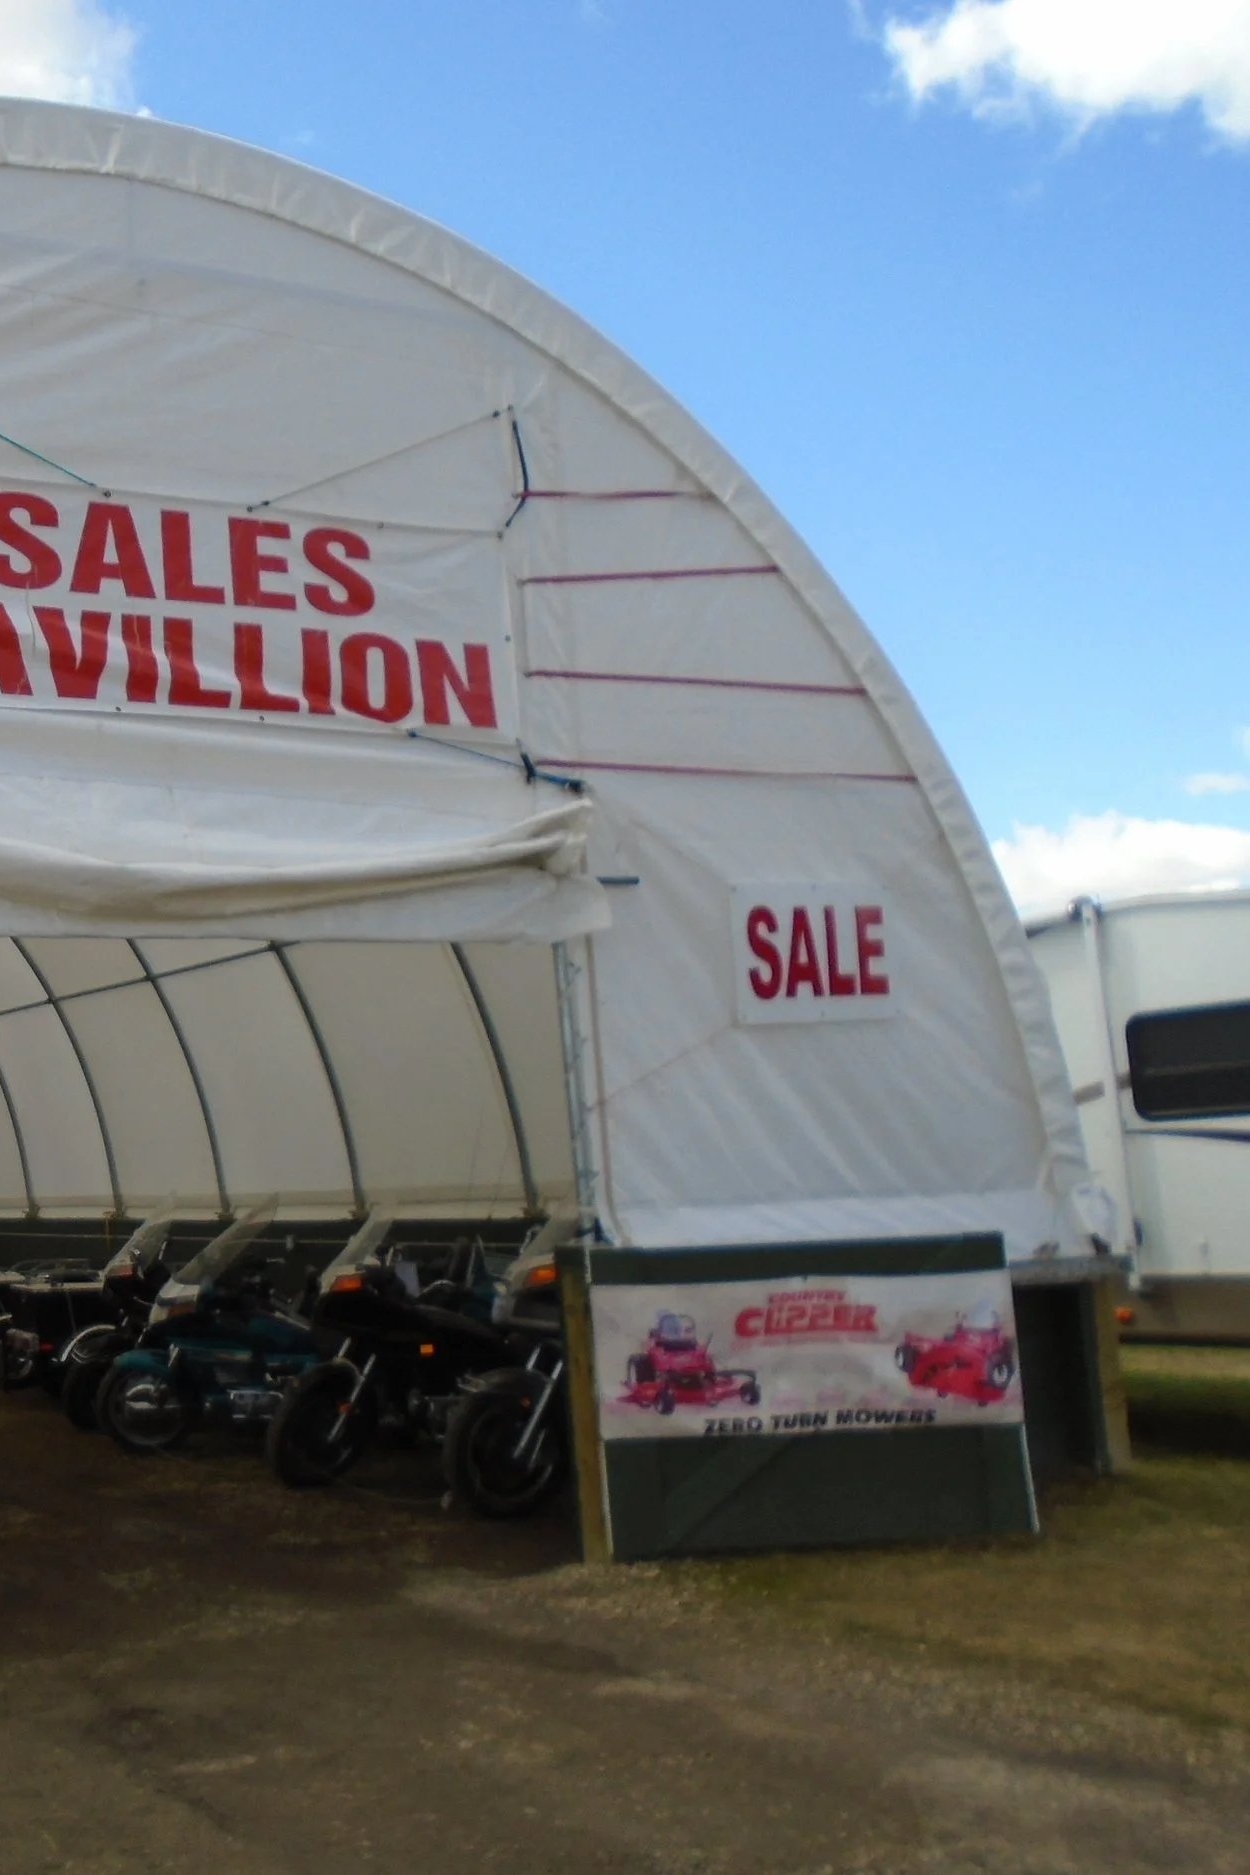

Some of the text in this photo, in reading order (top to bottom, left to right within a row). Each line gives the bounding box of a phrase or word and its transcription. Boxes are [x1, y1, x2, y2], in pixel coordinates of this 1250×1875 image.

[747, 905, 890, 1000] SALE
[734, 1305, 878, 1338] CLIPPER
[703, 1408, 937, 1435] ZERO TURN MOWERS
